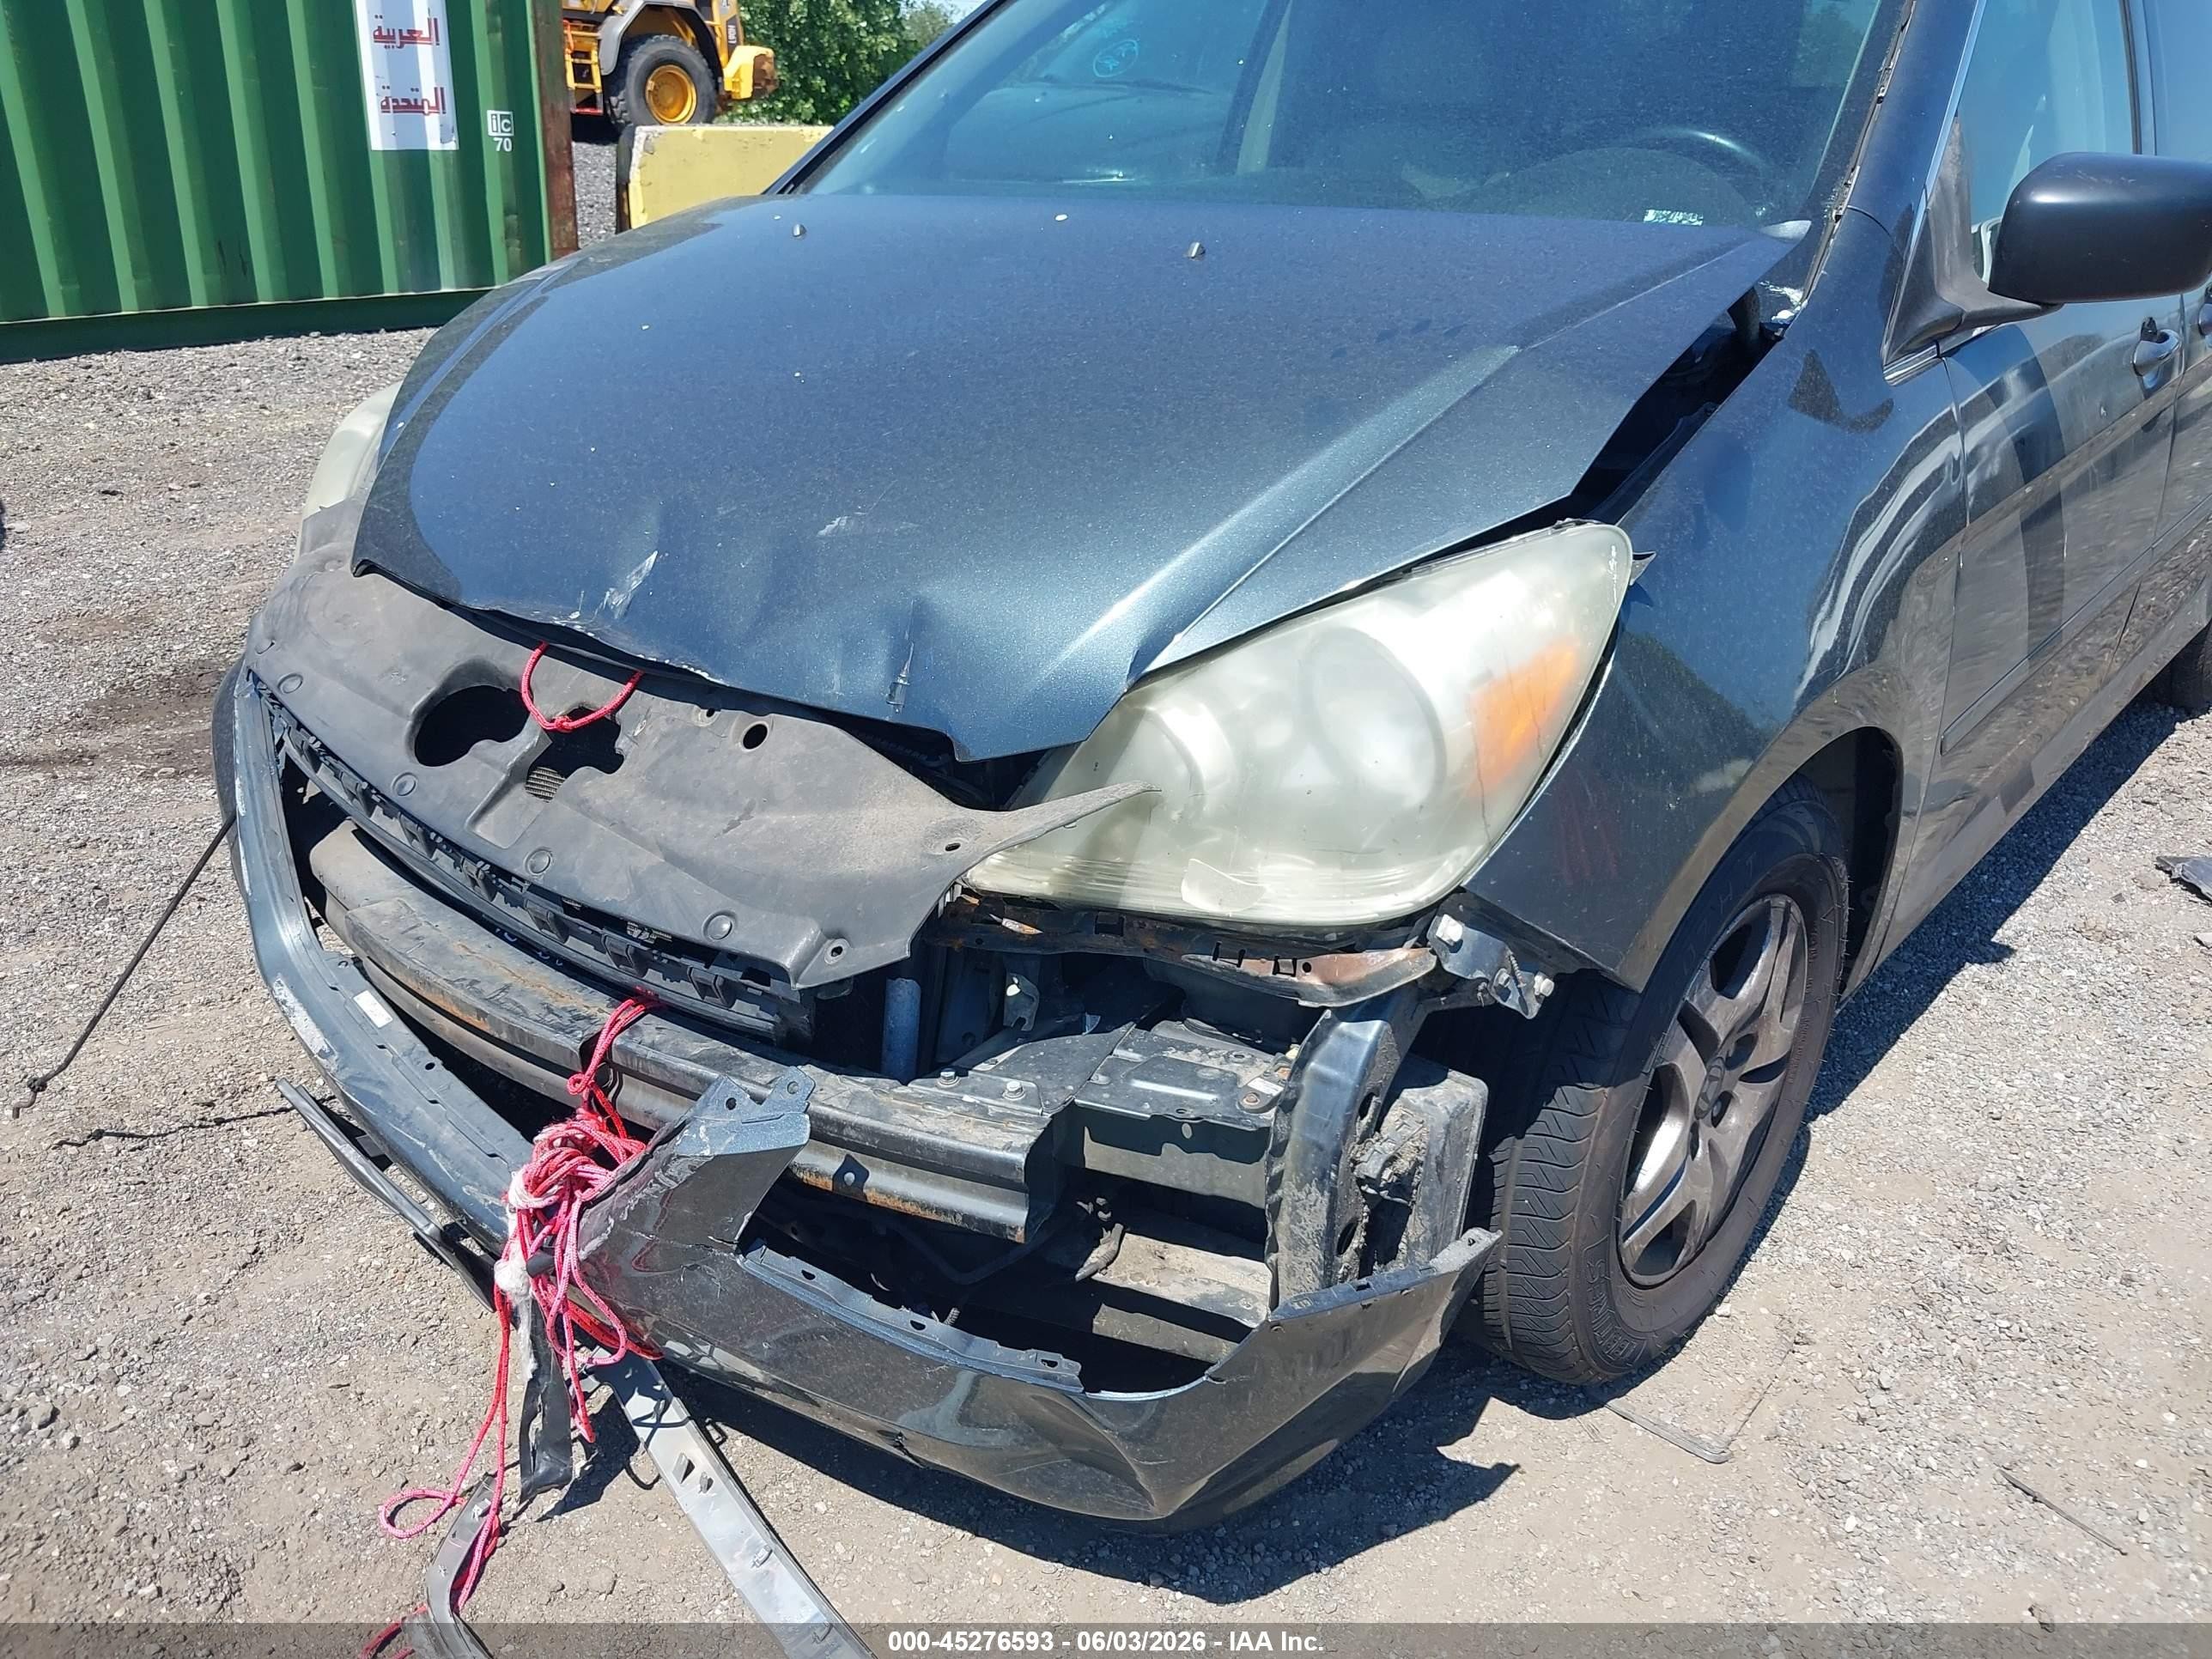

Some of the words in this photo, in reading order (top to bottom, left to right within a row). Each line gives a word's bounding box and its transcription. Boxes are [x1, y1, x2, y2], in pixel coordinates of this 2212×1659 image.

[373, 15, 441, 49] العربية
[380, 85, 447, 116] المتحدة
[493, 137, 513, 152] 70
